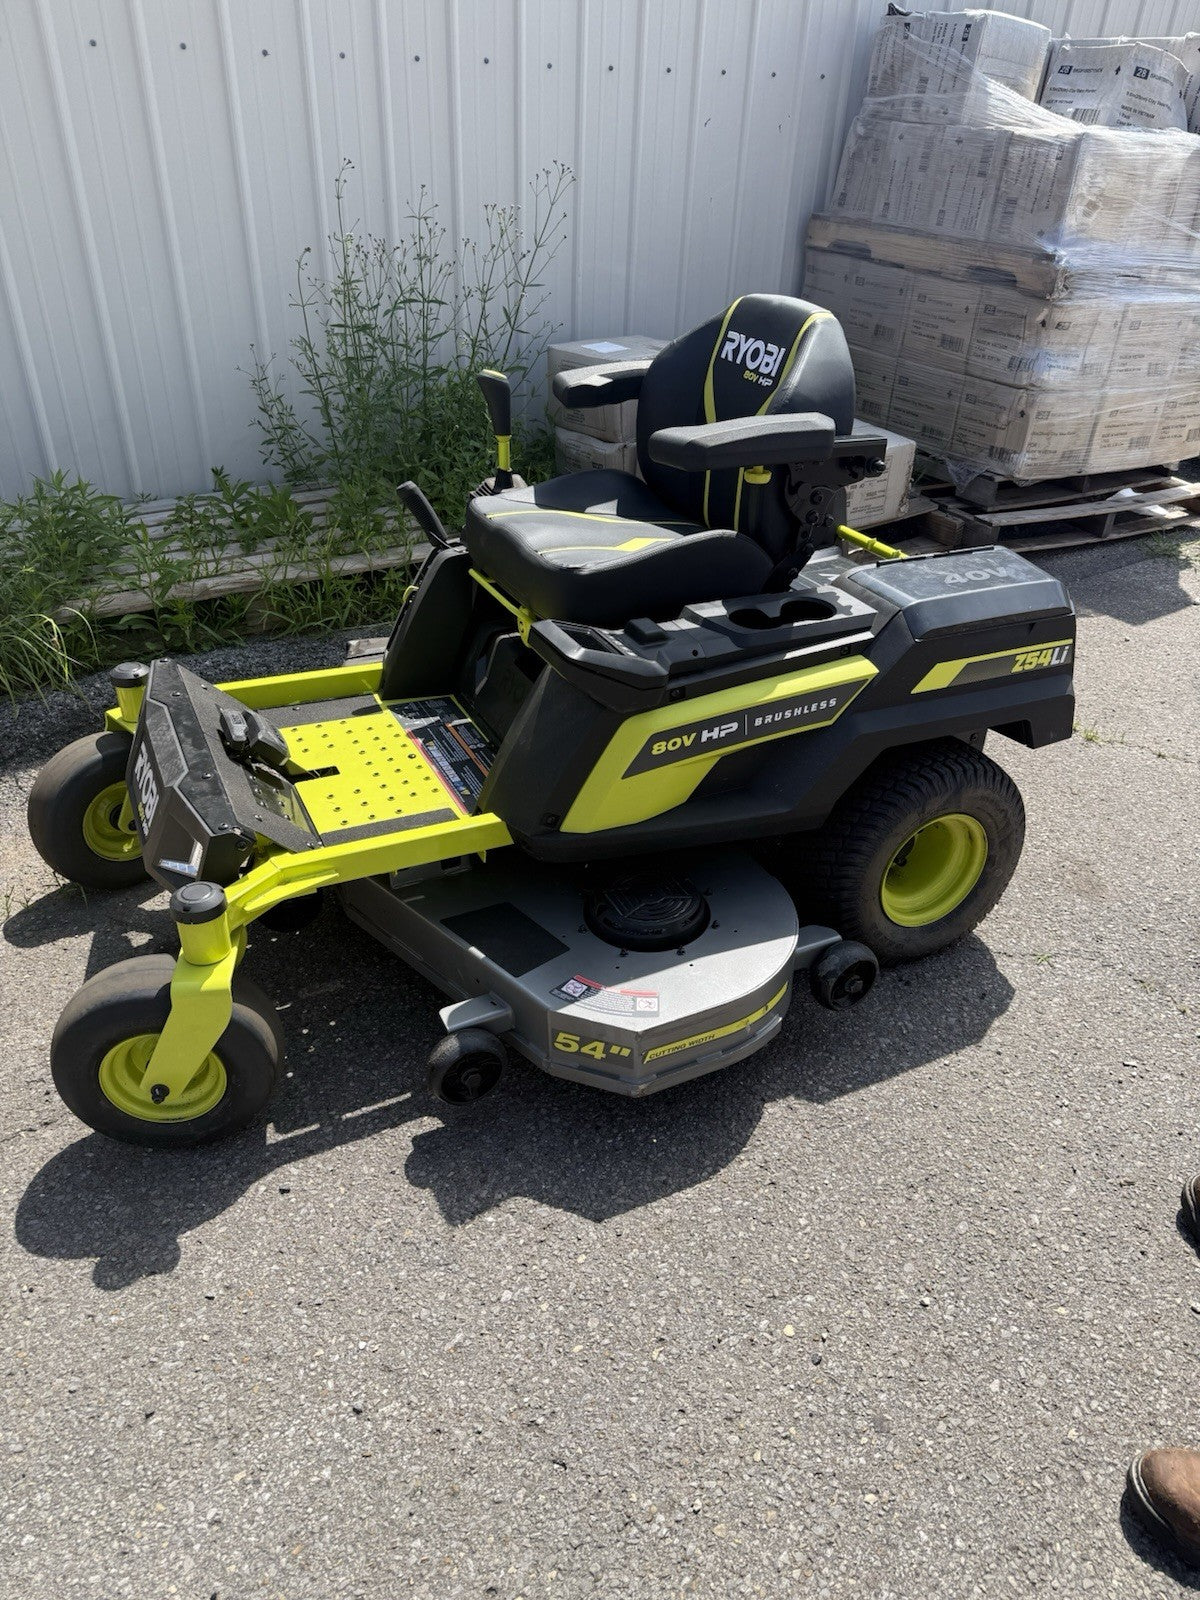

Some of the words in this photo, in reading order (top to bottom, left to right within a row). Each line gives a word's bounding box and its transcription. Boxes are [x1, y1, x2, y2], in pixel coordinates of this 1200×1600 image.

[720, 330, 786, 378] RYOBI
[743, 370, 759, 383] 80V
[757, 375, 773, 387] HP
[1010, 646, 1070, 673] Z54Li
[650, 732, 697, 756] 80V
[700, 721, 739, 743] HP
[753, 697, 837, 727] BRUSHLESS
[134, 741, 160, 828] RYOBI
[553, 1032, 632, 1060] 54"
[649, 1043, 687, 1059] CUTTING
[688, 1034, 715, 1046] WIDTH
